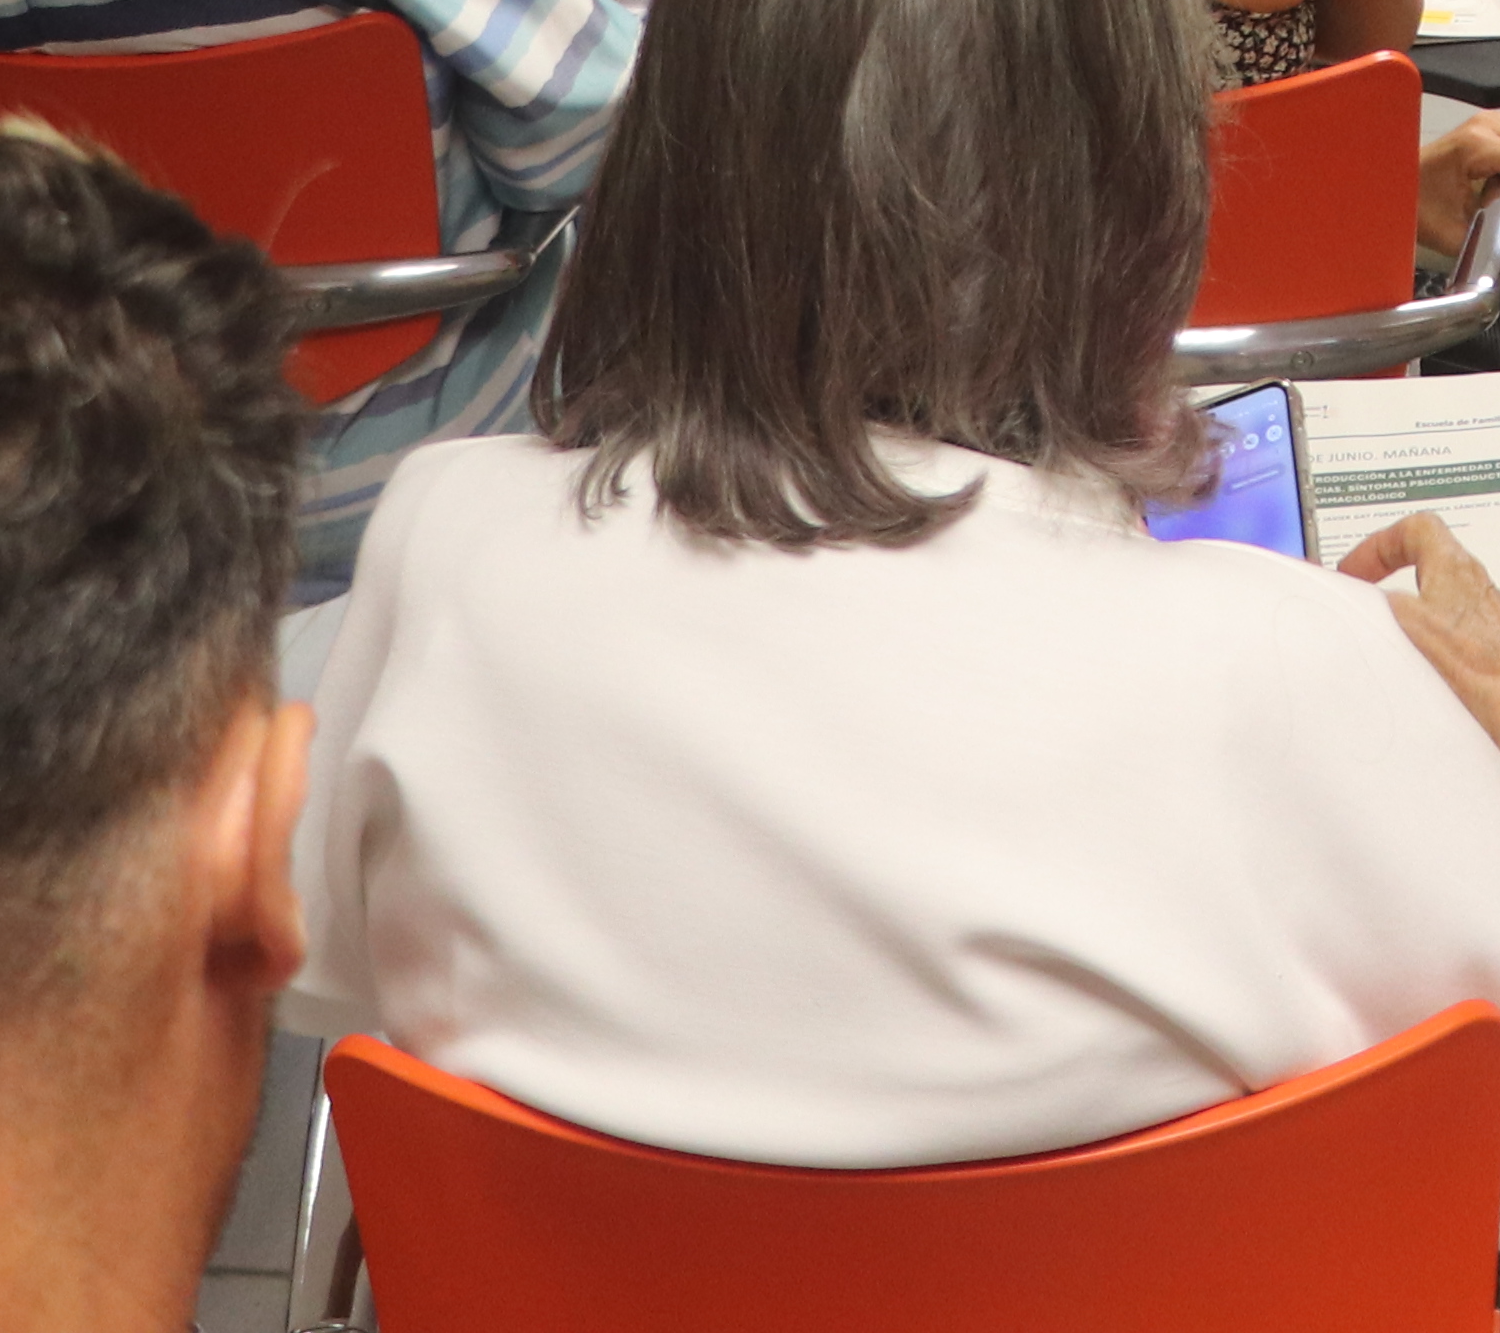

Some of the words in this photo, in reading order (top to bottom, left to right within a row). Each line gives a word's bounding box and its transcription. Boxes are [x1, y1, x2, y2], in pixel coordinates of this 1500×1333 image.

[1383, 445, 1452, 460] MAÑANA
[1415, 463, 1493, 476] ENFERMEDAD
[1314, 491, 1407, 505] ARMACOLÓGICO
